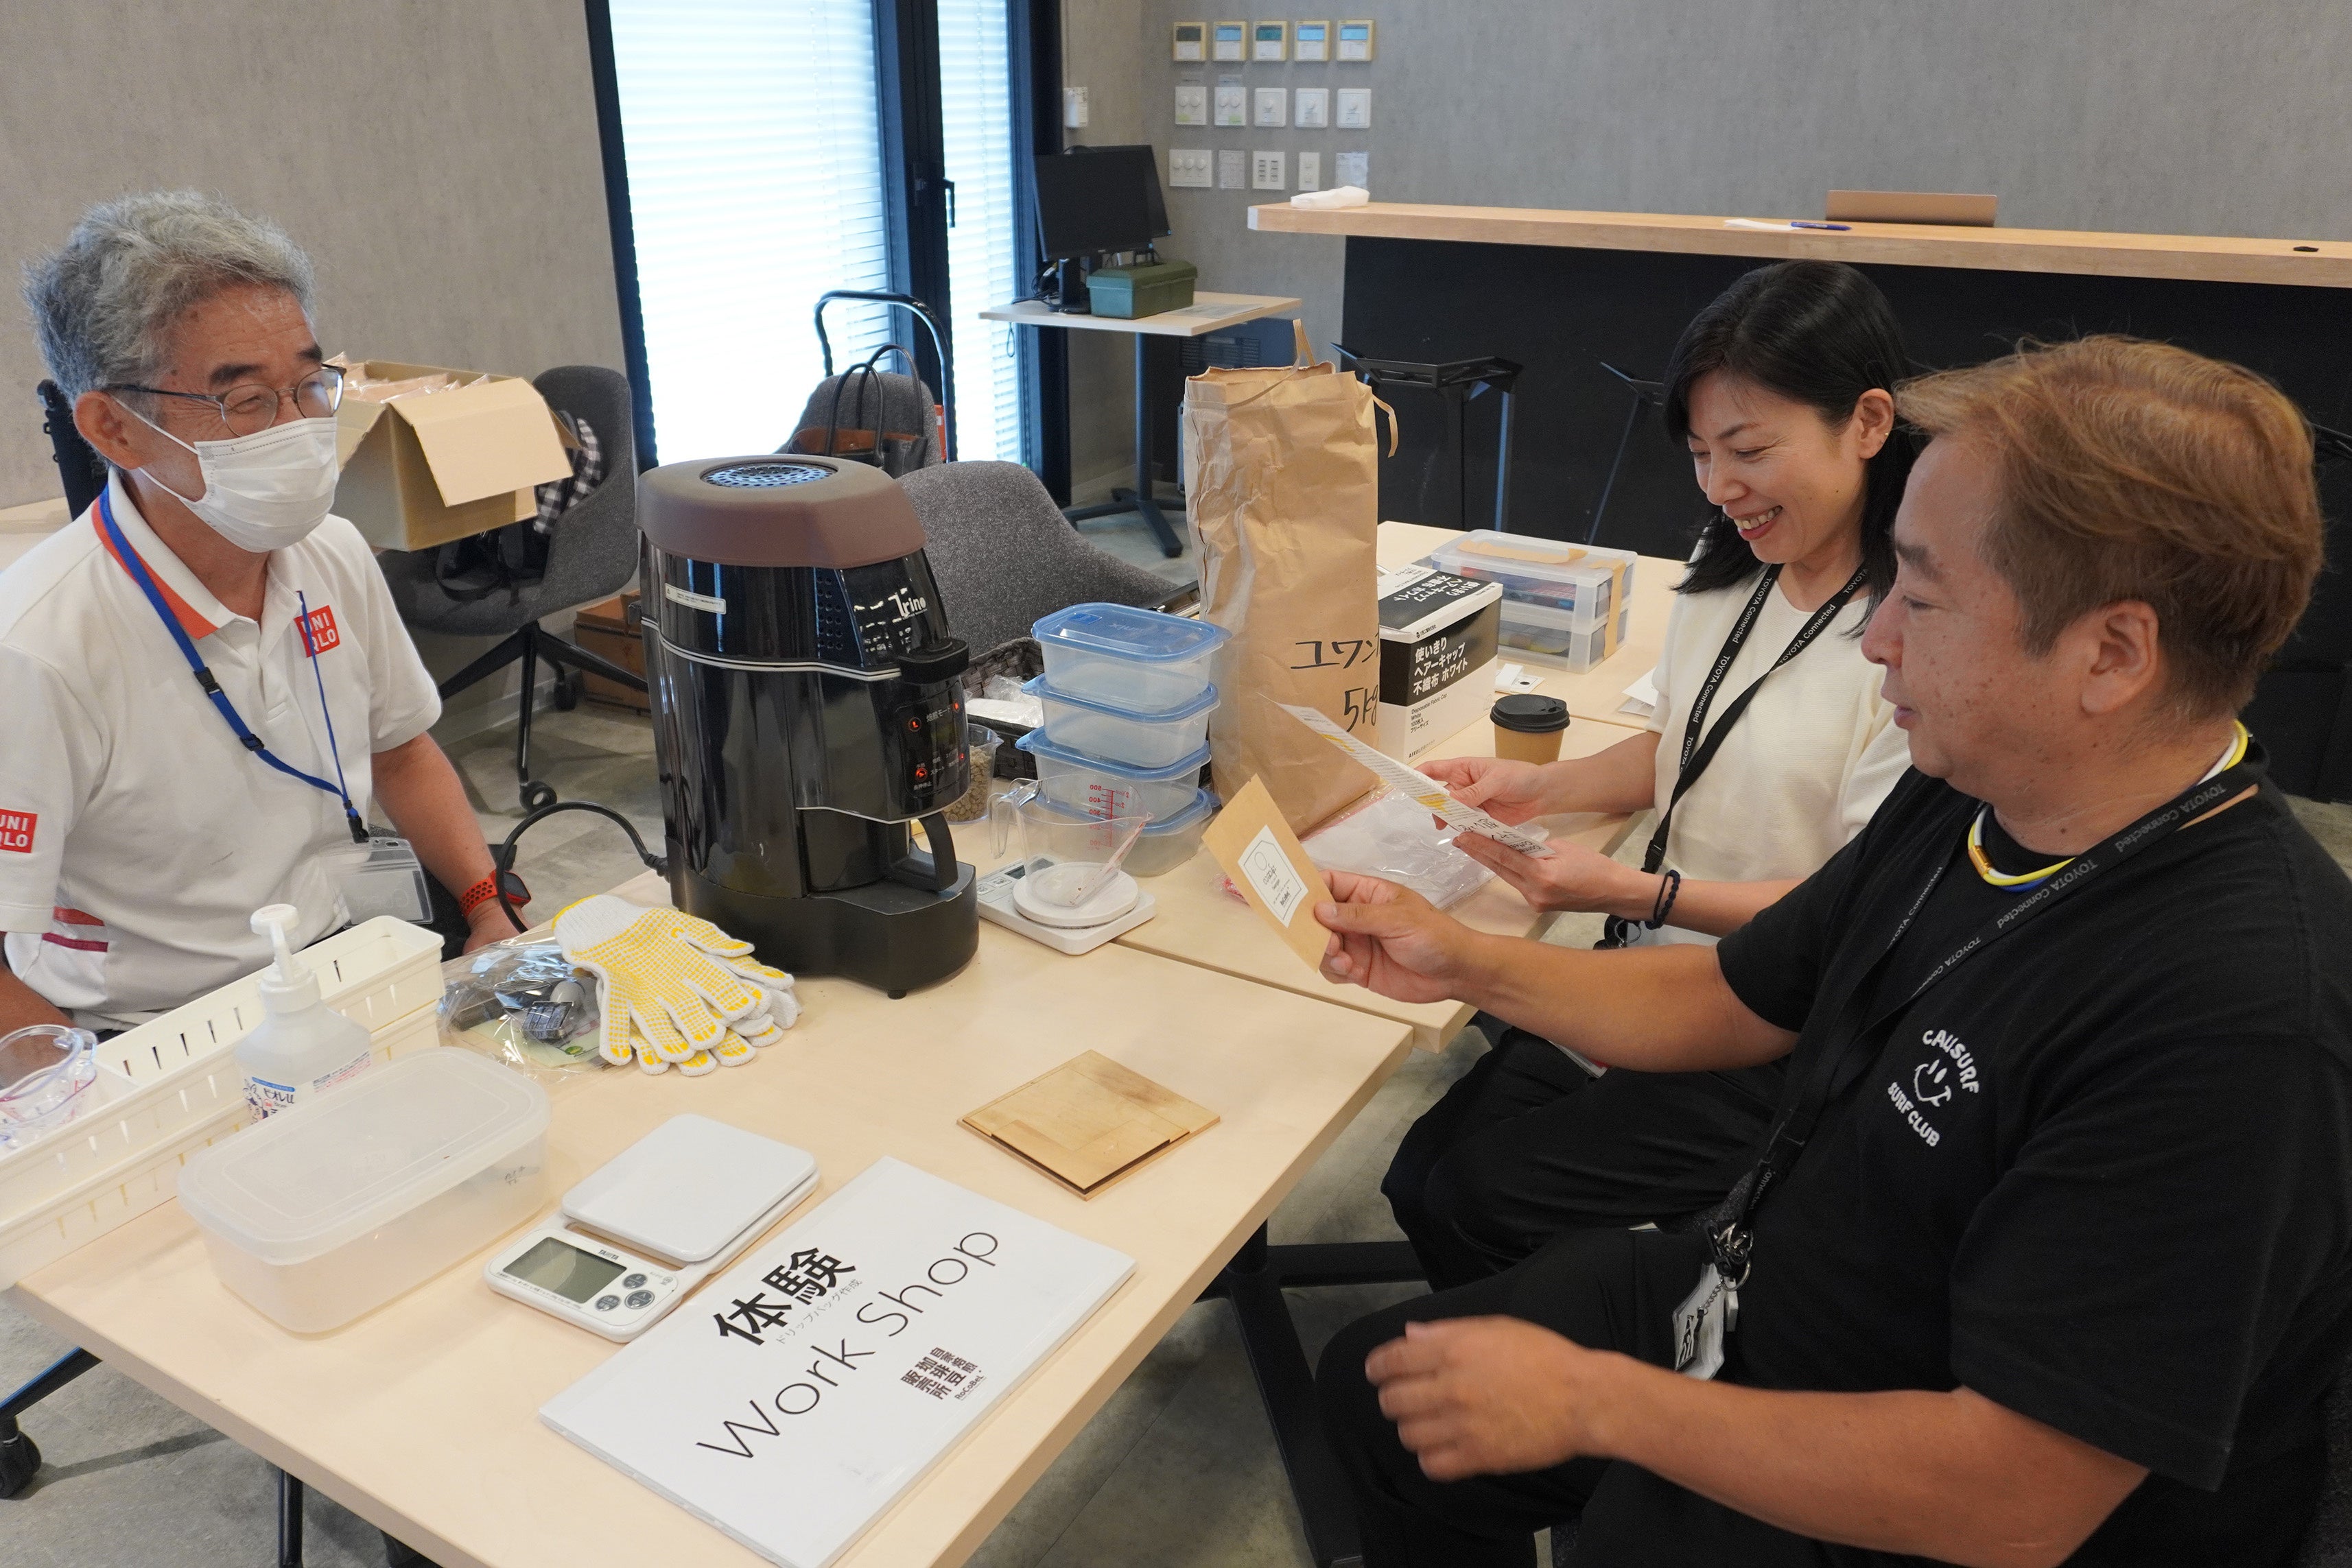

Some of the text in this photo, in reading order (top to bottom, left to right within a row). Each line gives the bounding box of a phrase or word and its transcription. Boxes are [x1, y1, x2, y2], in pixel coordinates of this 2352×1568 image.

[1732, 577, 1772, 644] TOYOTA Connected
[1779, 604, 1836, 664] TOYOTA Connected
[1414, 642, 1466, 676] ヘアーキャップ
[1415, 637, 1447, 663] 使いきり
[1413, 657, 1468, 696] 不織布 ホワイト
[1693, 655, 1730, 724] TOYOTA Connected
[1681, 737, 1694, 765] TOYOTA
[0, 831, 29, 848] LO
[2114, 782, 2228, 853] TOYOTA Connected
[1996, 857, 2099, 929] TOYOTA Connected
[1944, 936, 1982, 966] TOYOTA
[1888, 1082, 1940, 1147] SURF CLUB
[712, 1246, 856, 1346] 体験
[696, 1232, 999, 1459] Work Shop
[900, 1369, 952, 1401] 販売所
[915, 1356, 967, 1386] 珈琲豆
